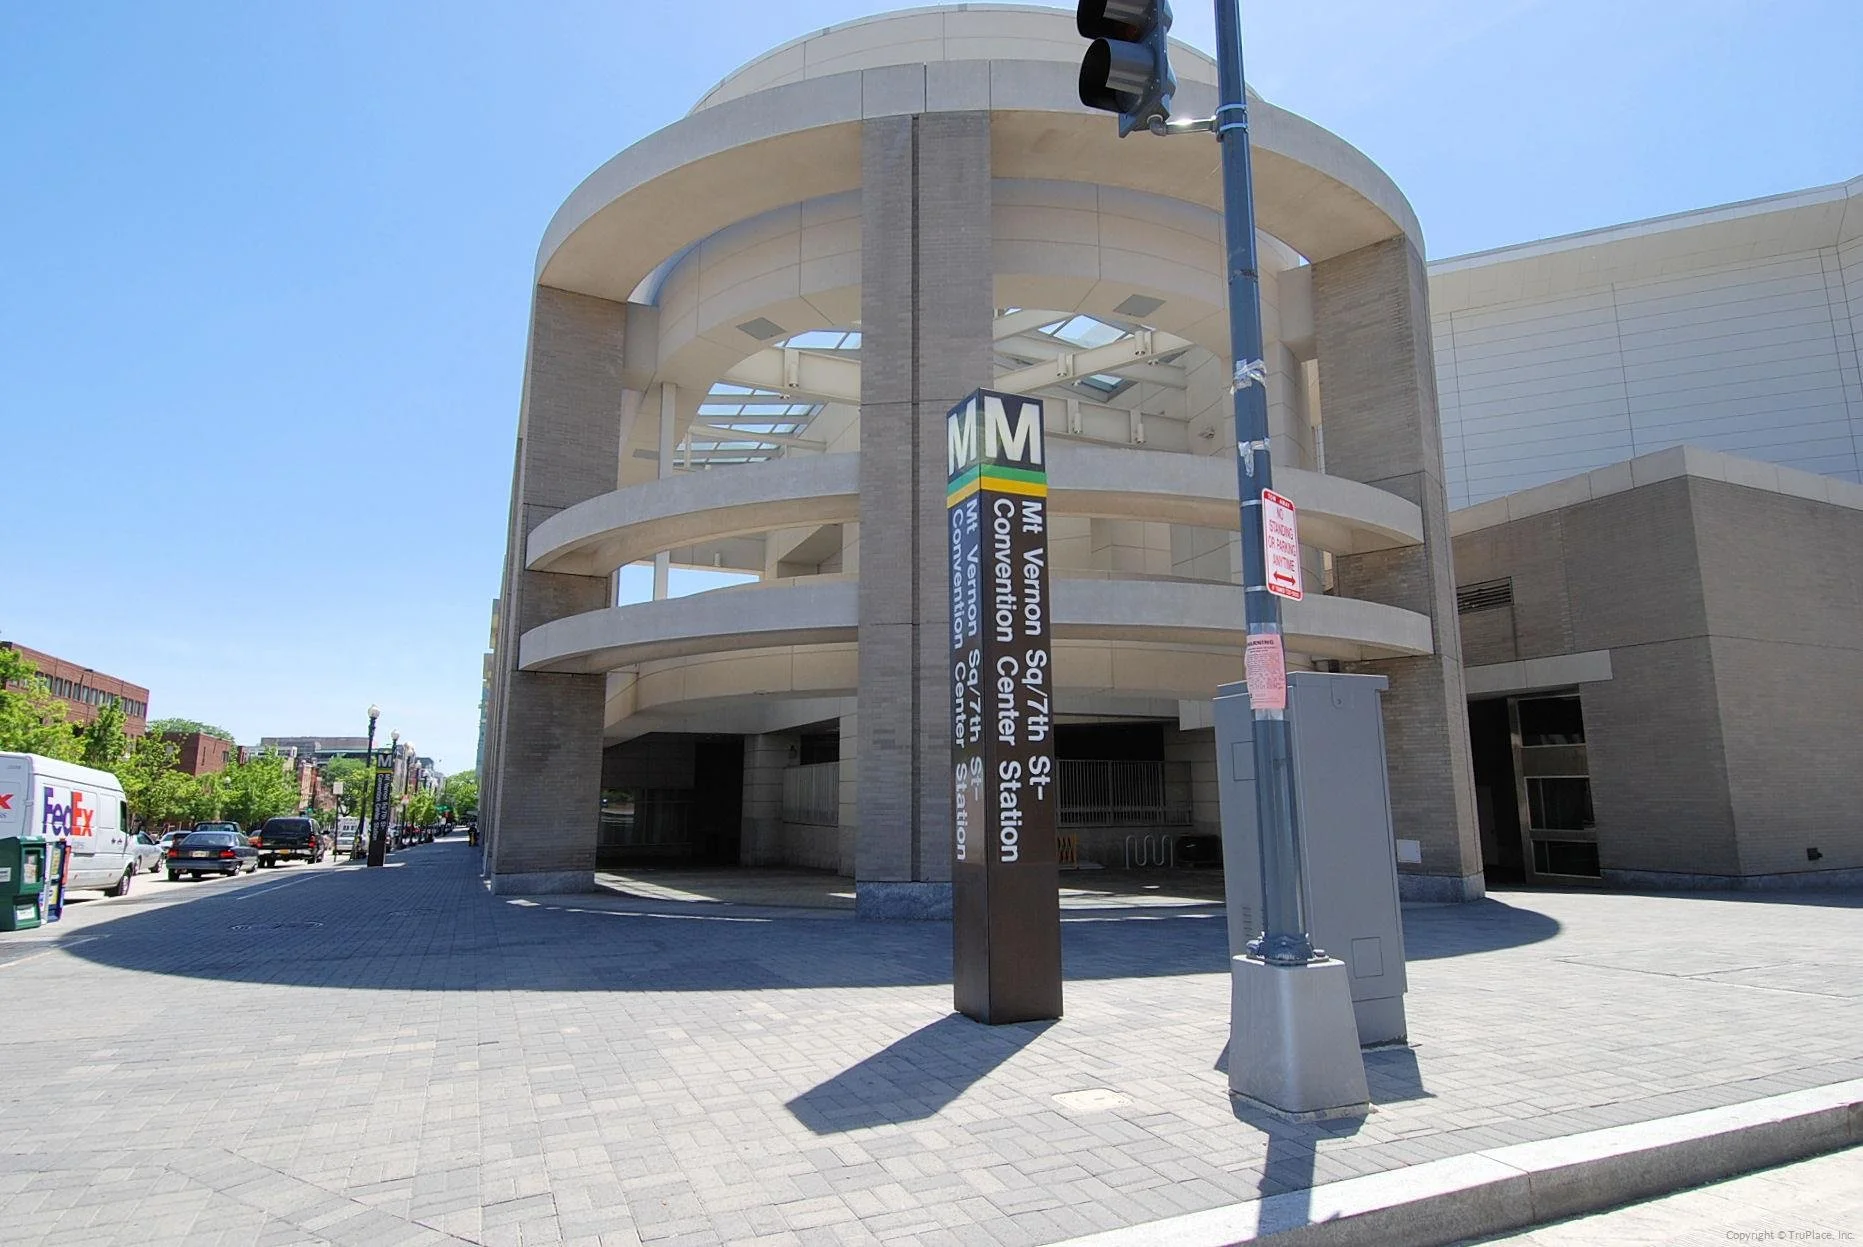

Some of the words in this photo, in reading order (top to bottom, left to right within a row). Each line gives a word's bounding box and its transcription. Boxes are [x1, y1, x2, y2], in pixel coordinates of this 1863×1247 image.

[948, 397, 977, 477] M
[984, 395, 1042, 465] M
[965, 496, 978, 534] Mt
[1021, 501, 1043, 533] Mt
[1268, 519, 1294, 540] STANDING
[1276, 538, 1296, 556] PARKING
[952, 509, 964, 649] Convention
[966, 544, 979, 636] Vernon
[993, 498, 1017, 643] Convention
[1022, 548, 1044, 636] Vernon
[1272, 554, 1295, 572] ANYTIME
[954, 662, 967, 749] Center
[967, 648, 981, 742] Sq/7th
[996, 655, 1020, 747] Center
[1021, 648, 1049, 742] Sq/7th
[378, 754, 392, 767] M
[1028, 755, 1051, 801] St-
[42, 787, 94, 837] FedEx
[955, 763, 968, 861] Station
[999, 760, 1023, 863] Station
